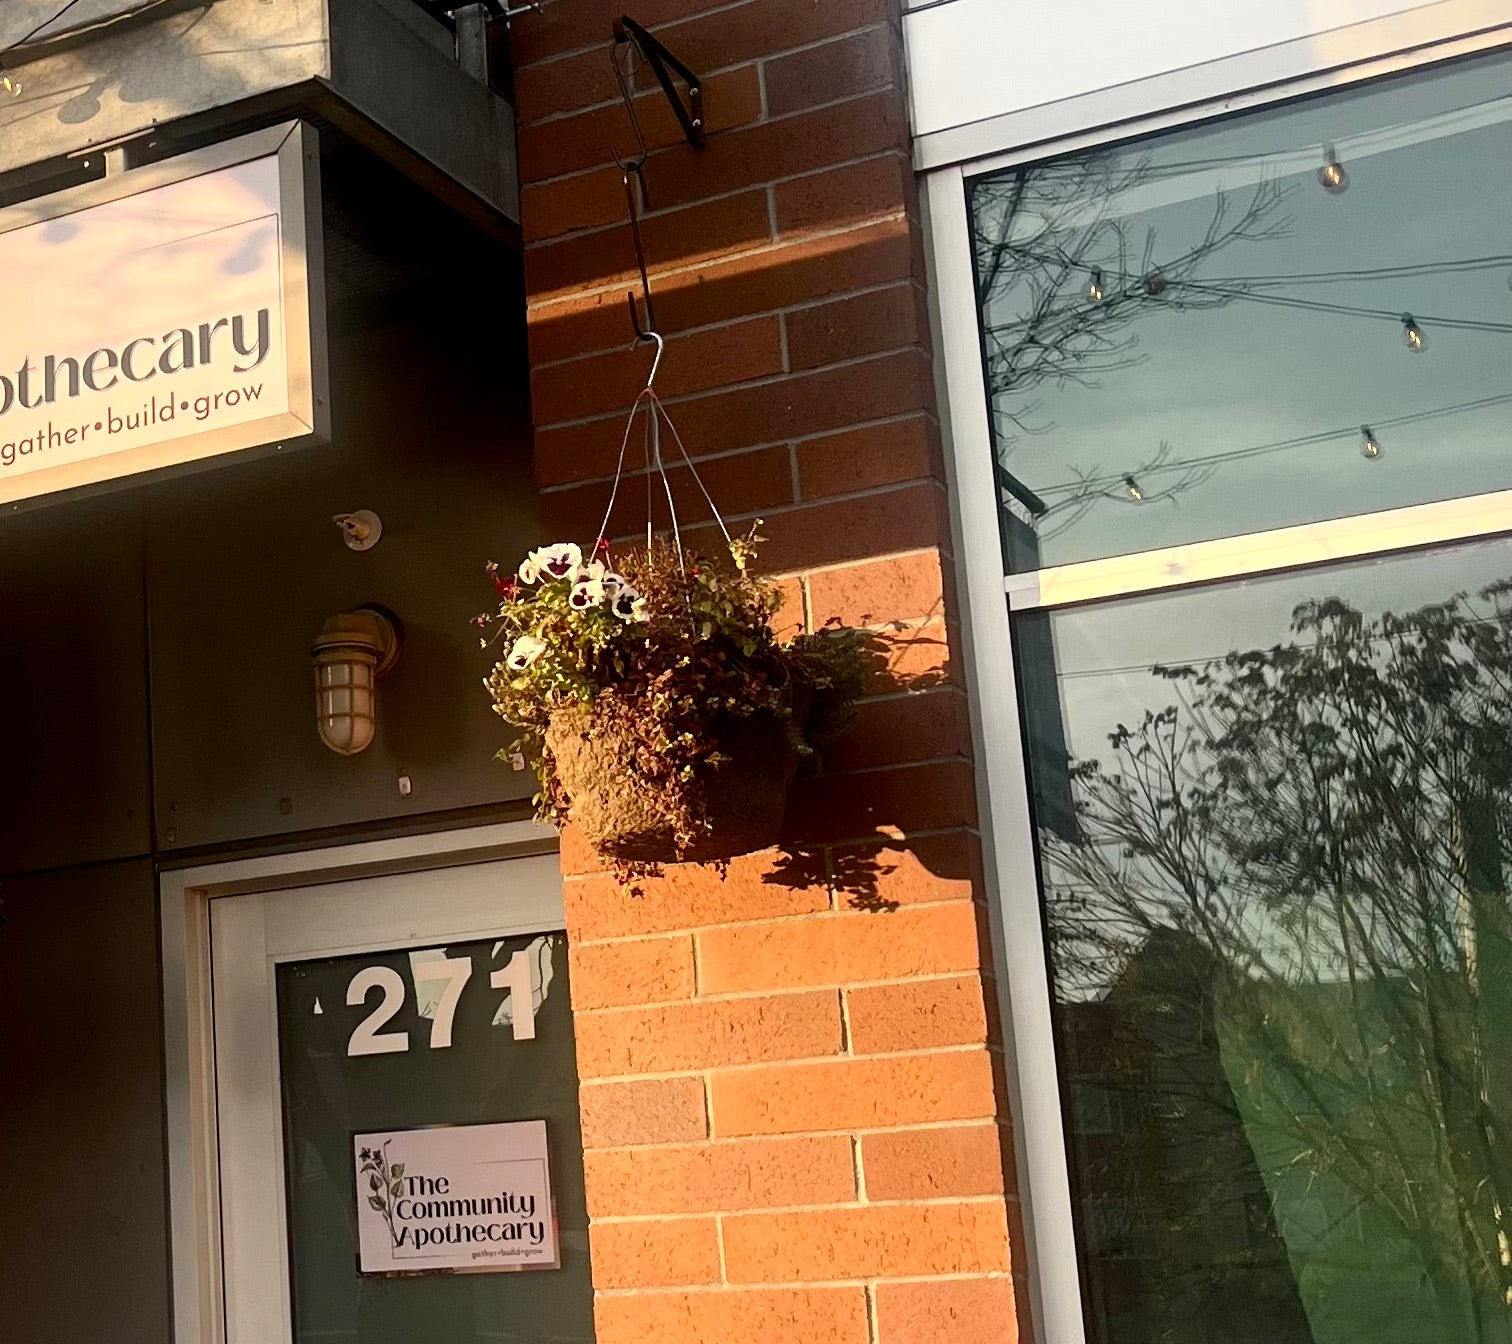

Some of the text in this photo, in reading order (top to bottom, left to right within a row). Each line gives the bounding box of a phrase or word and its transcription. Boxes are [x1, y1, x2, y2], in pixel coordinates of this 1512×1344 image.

[345, 949, 537, 1057] 271
[404, 1175, 450, 1196] The
[396, 1191, 536, 1221] Community
[396, 1221, 544, 1250] Apothecary
